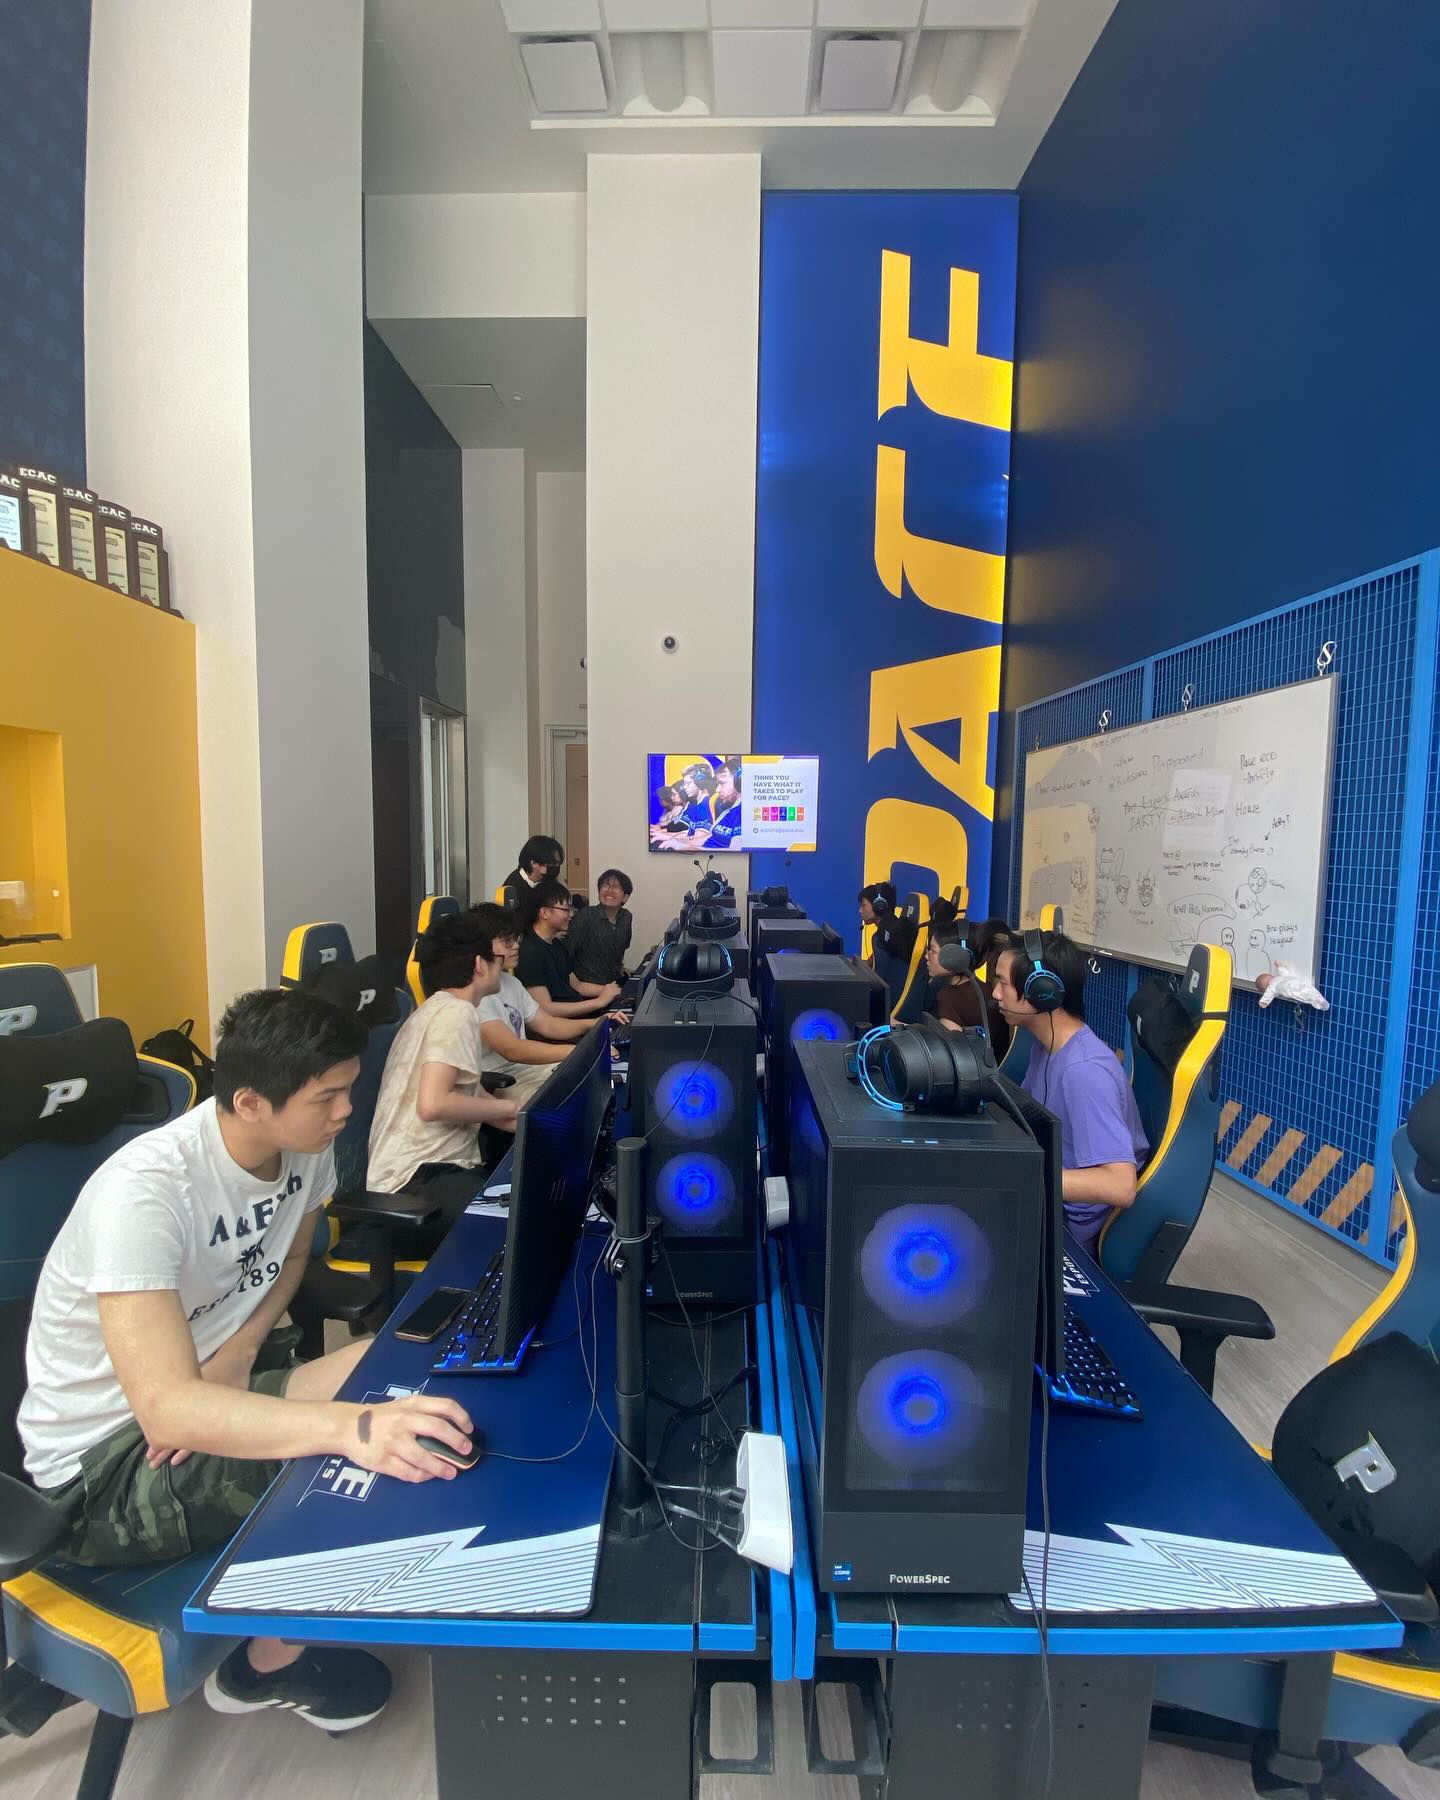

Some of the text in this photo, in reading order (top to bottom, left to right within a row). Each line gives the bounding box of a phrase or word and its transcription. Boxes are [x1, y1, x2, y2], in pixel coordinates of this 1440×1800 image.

[0, 474, 20, 488] AC
[20, 468, 56, 483] ECAC
[861, 248, 1013, 983] PACE
[39, 1078, 88, 1118] P
